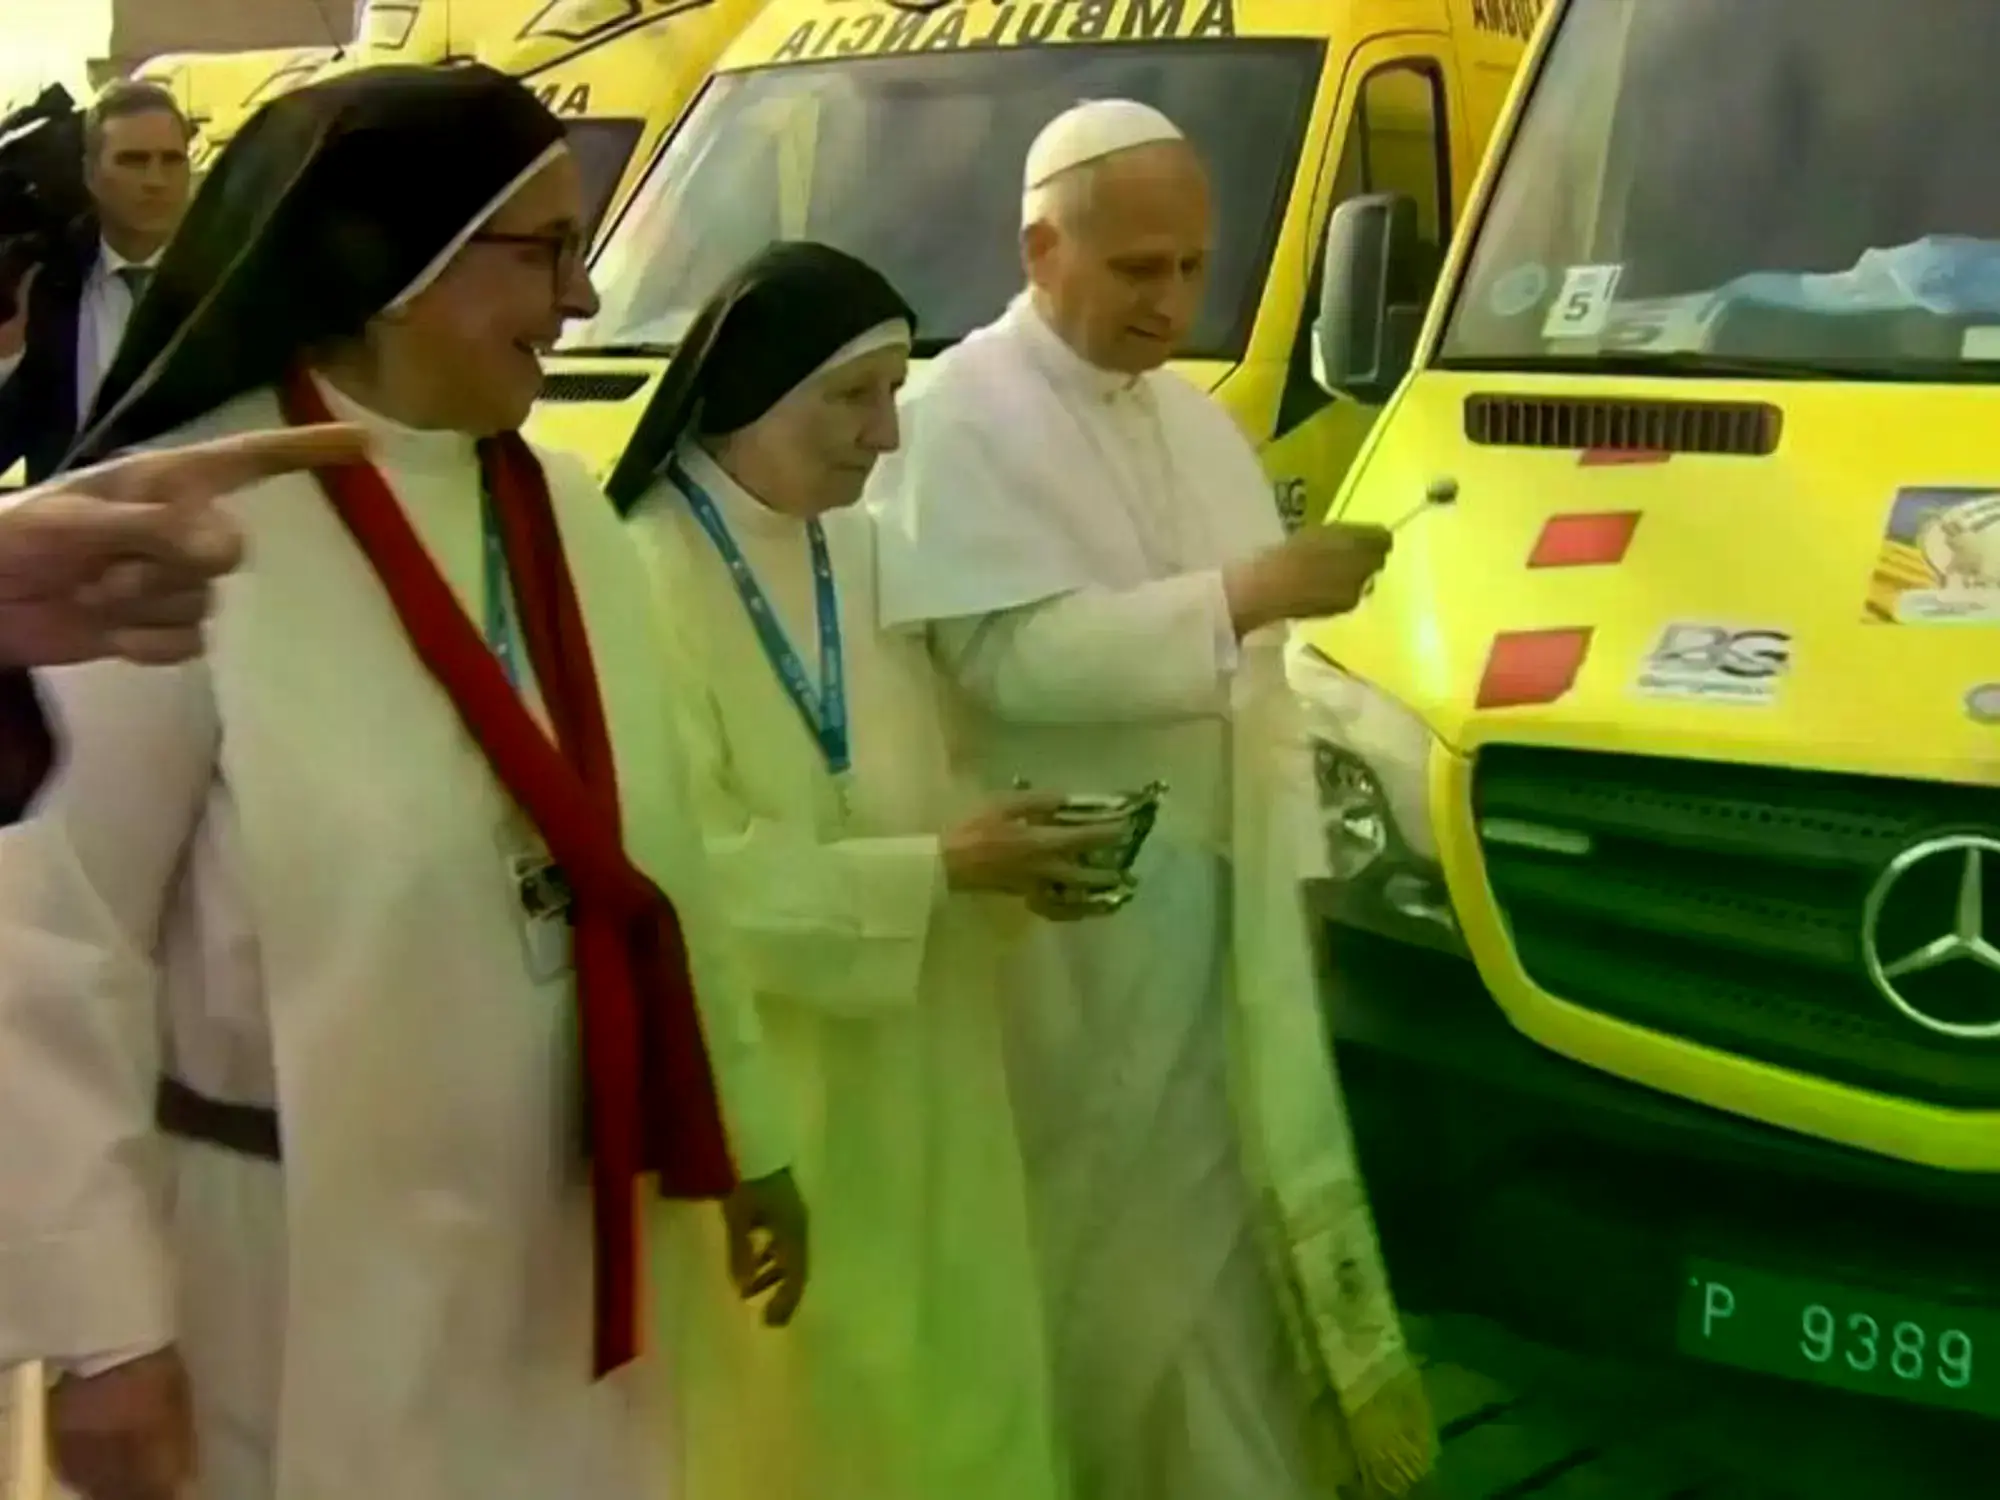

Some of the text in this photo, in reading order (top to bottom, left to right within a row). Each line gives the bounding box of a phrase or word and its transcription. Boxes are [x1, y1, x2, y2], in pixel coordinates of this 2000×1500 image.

[1563, 292, 1592, 322] 5
[1703, 1282, 1973, 1389] P 9389
